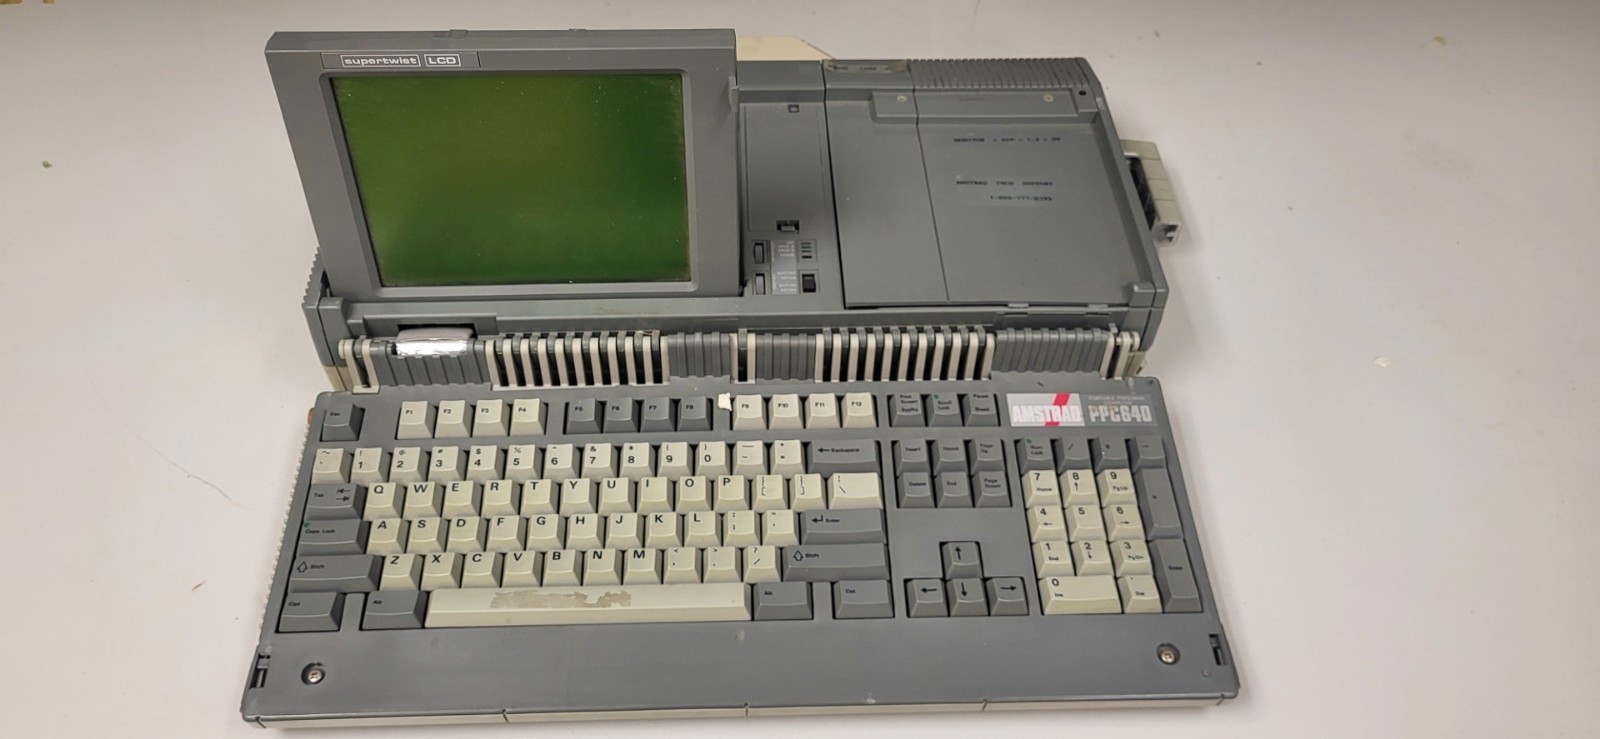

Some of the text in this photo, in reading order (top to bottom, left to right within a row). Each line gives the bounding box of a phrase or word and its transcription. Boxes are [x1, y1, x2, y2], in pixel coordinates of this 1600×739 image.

[344, 56, 456, 66] supertwist LCD
[1012, 405, 1082, 422] AMSTRAD
[1088, 405, 1152, 422] PPC640
[513, 458, 520, 466] 5
[569, 481, 578, 489] Y
[607, 480, 616, 489] U
[723, 477, 731, 486] P
[374, 485, 384, 494] Q
[413, 484, 428, 493] W
[452, 483, 460, 492] E
[490, 483, 499, 491] R
[531, 482, 539, 490] T
[497, 518, 505, 526] F
[536, 517, 546, 525] G
[576, 516, 585, 524] H
[616, 516, 623, 524] J
[694, 514, 701, 522] L
[378, 521, 387, 529] A
[417, 520, 426, 528] S
[457, 519, 466, 527] D
[472, 554, 482, 562] C
[552, 552, 561, 560] B
[592, 551, 603, 559] N
[634, 550, 645, 558] M
[390, 556, 400, 564] Z
[432, 555, 442, 563] X
